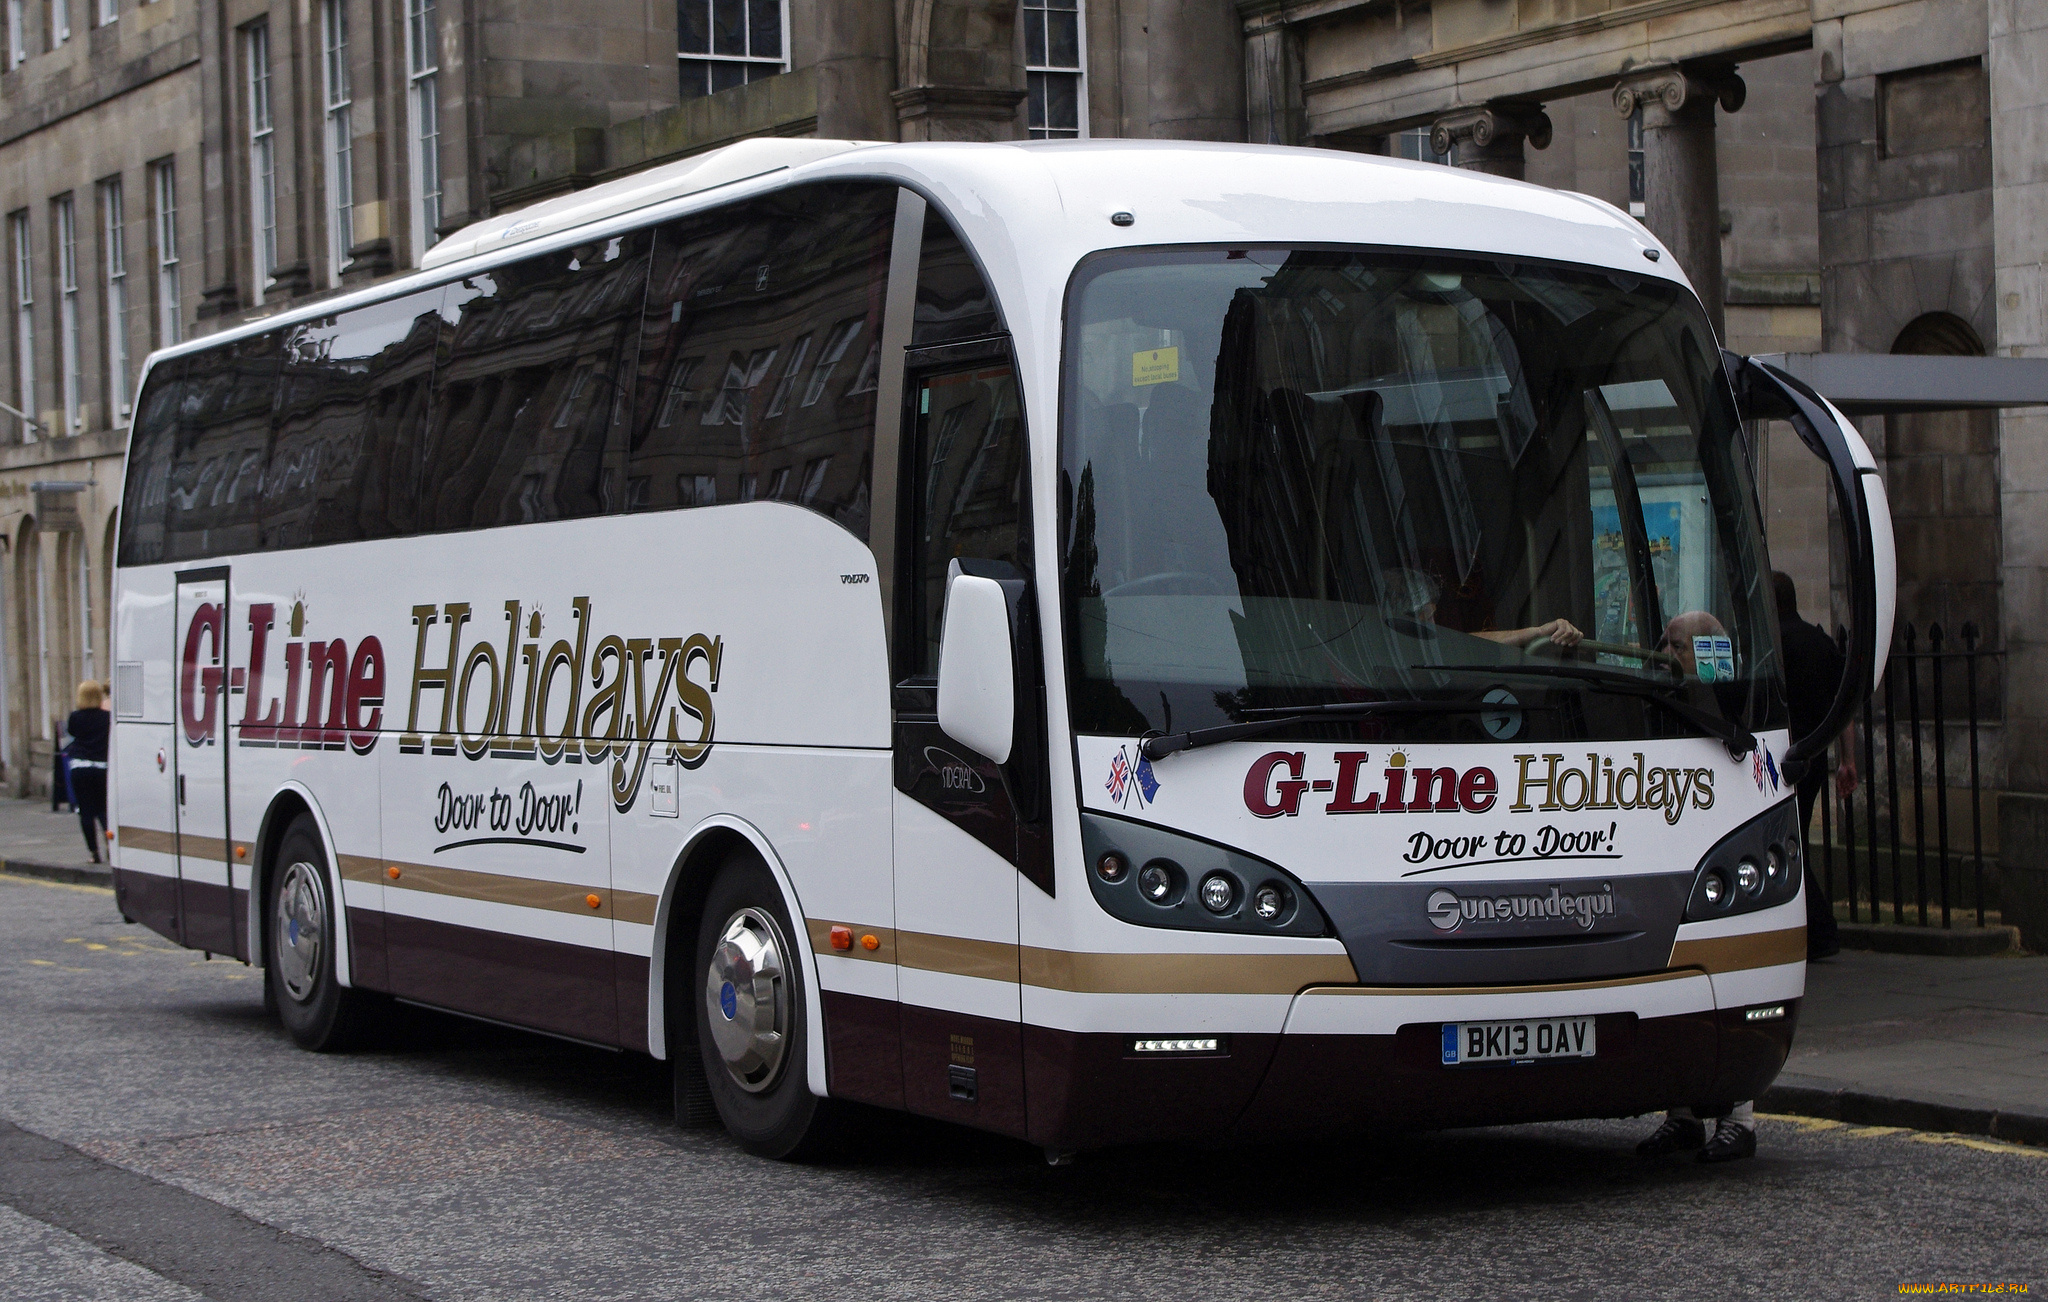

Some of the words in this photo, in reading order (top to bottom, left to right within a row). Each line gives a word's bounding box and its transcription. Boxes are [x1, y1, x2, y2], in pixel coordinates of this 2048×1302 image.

[840, 574, 870, 584] VOLVO
[181, 600, 386, 756] G-Line
[399, 596, 723, 813] Holidays
[942, 766, 973, 790] SIDERAL
[1243, 747, 1498, 819] G-Line
[1509, 752, 1715, 825] Holidays
[434, 781, 486, 834] Door
[490, 787, 512, 832] to
[516, 779, 583, 836] Door!
[1403, 831, 1488, 864] Door
[1494, 830, 1526, 857] to
[1532, 821, 1618, 858] Door!
[1427, 881, 1616, 932] Sunsundegui
[1444, 1050, 1457, 1059] GB
[1467, 1025, 1529, 1058] BK13
[1537, 1021, 1587, 1054] OAV
